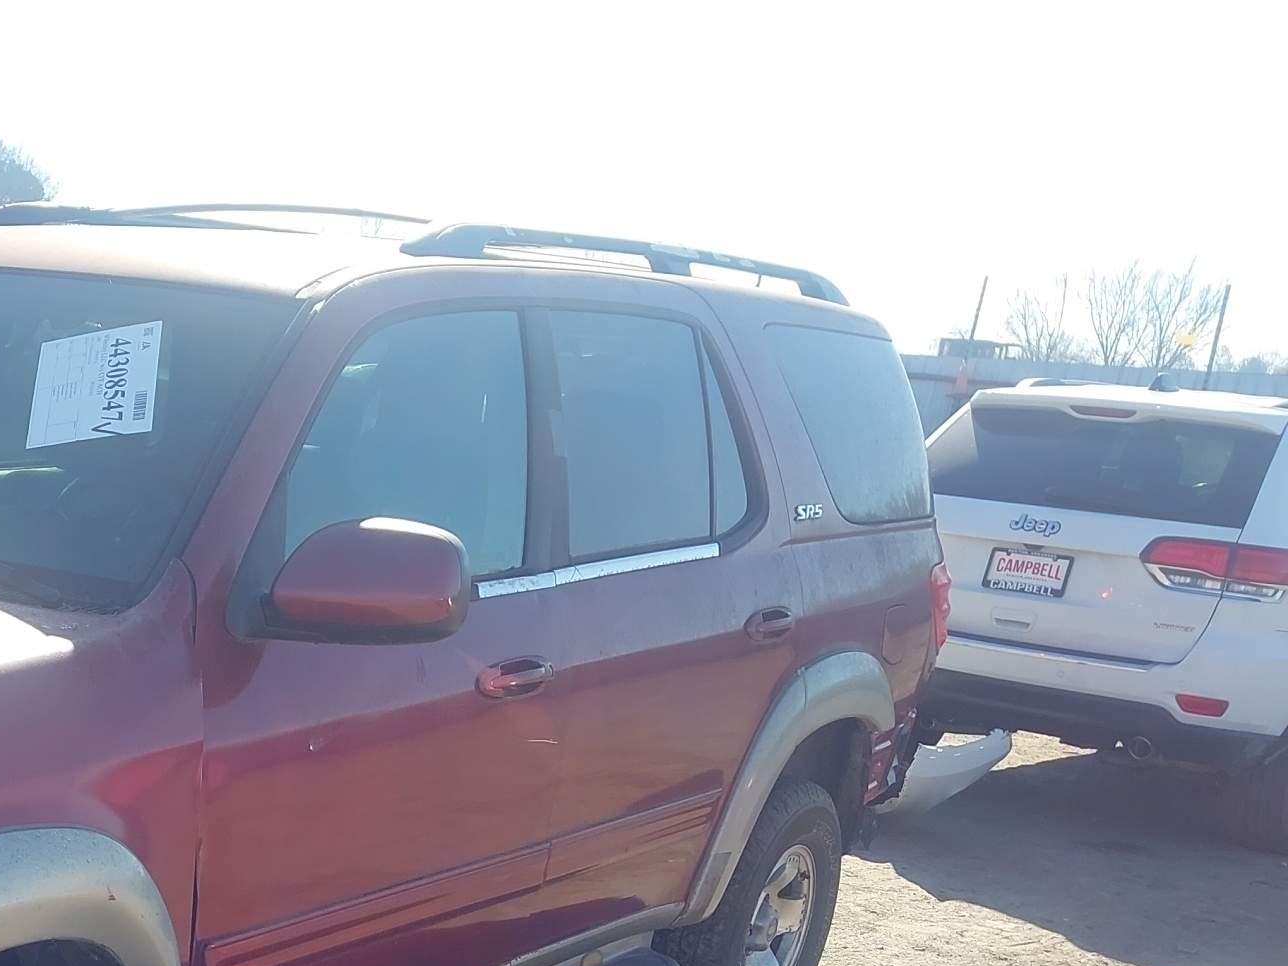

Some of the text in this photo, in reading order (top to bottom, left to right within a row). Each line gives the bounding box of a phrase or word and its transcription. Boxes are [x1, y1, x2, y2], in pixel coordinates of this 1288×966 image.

[100, 337, 132, 422] 44308547
[794, 503, 823, 521] SR5
[1009, 513, 1061, 537] Jeep
[996, 557, 1062, 581] CAMPBELL
[989, 579, 1055, 597] CAMPBELL
